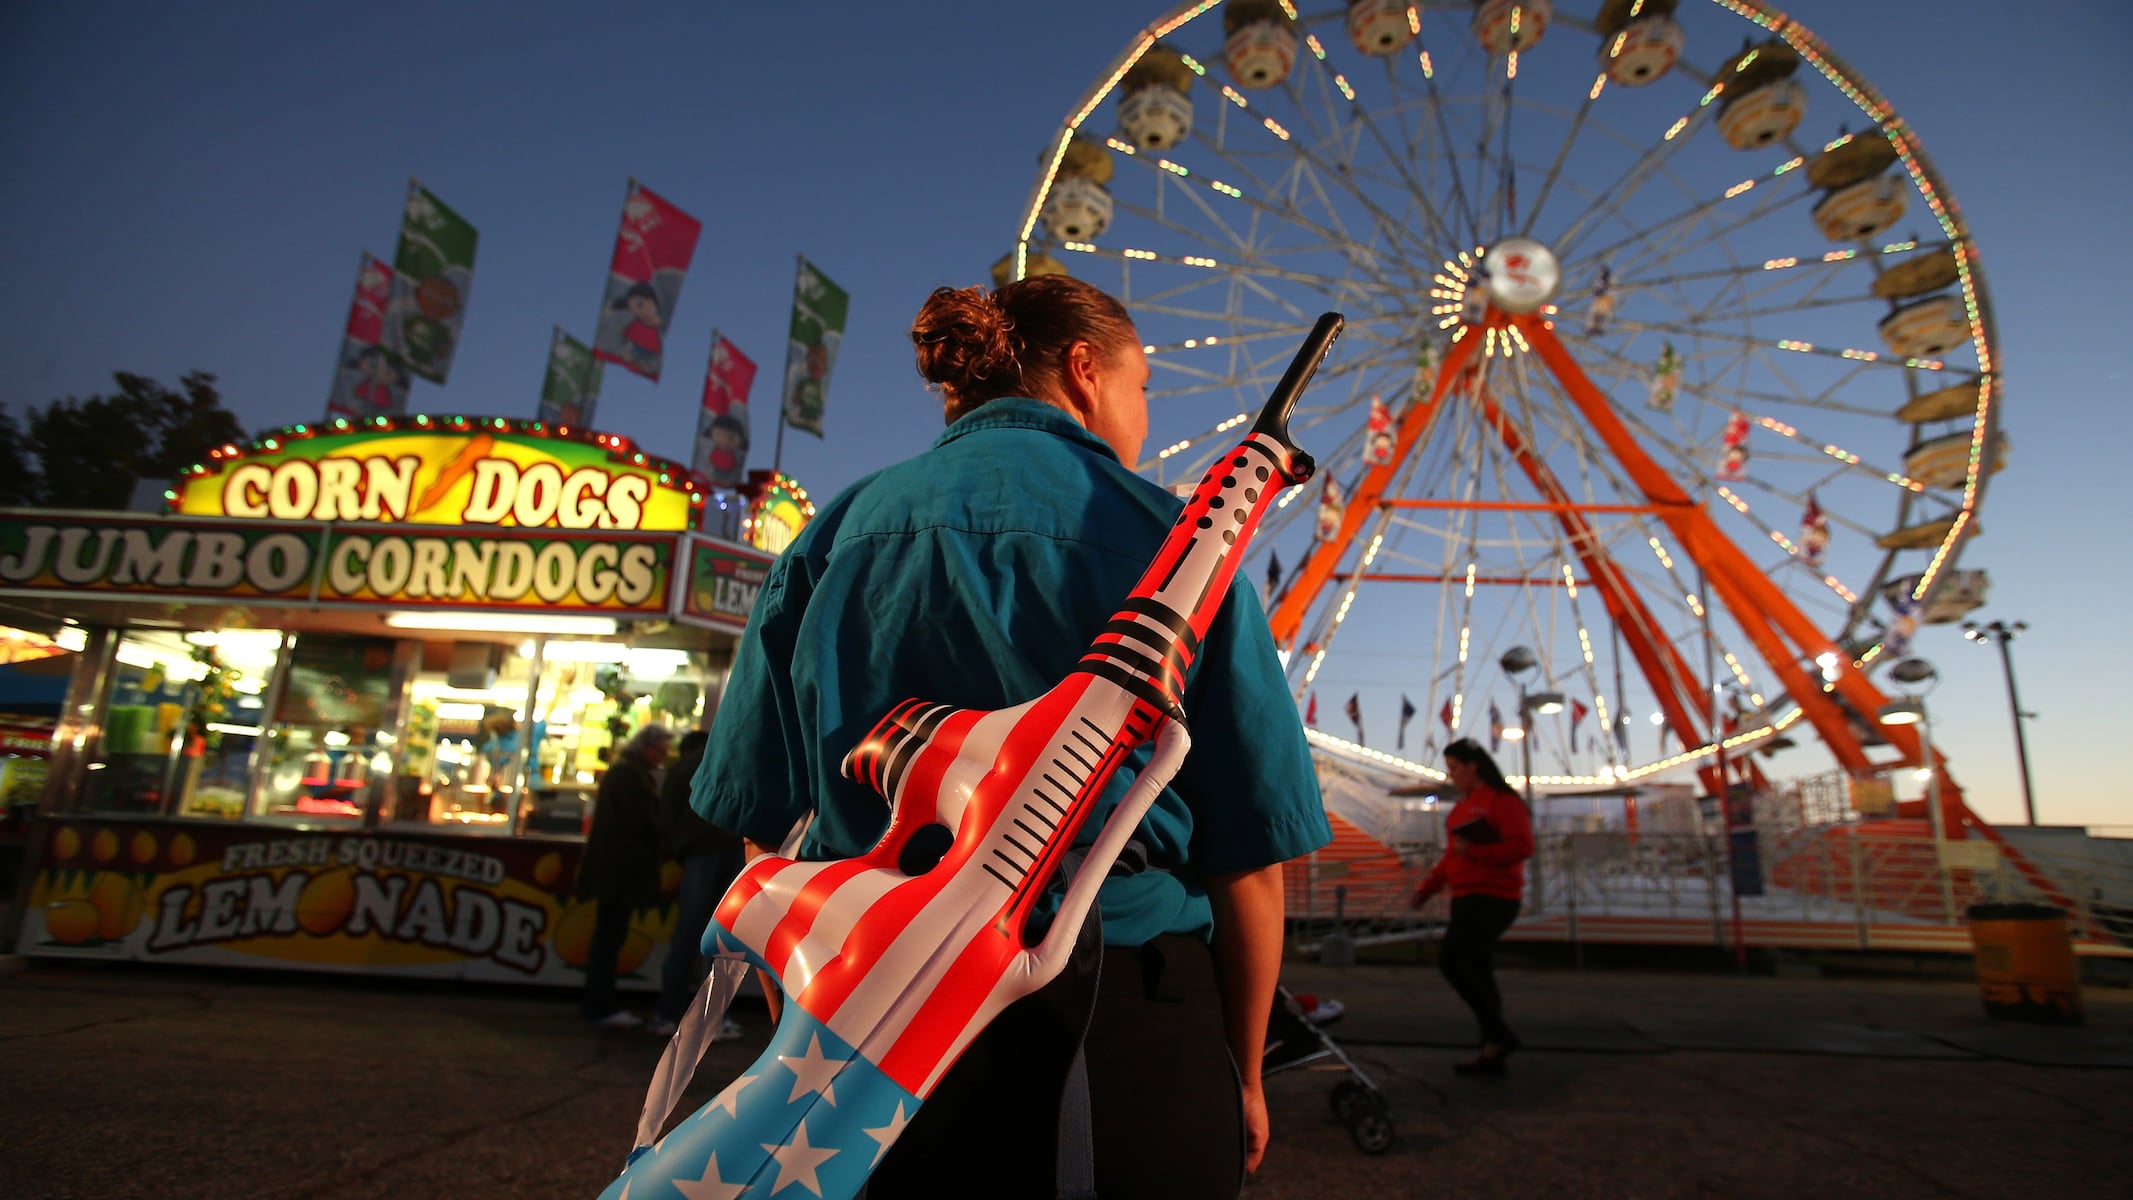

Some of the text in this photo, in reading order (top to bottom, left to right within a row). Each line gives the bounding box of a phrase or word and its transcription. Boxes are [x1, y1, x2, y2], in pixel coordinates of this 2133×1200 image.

[225, 457, 648, 529] CORN DOGS
[0, 526, 656, 603] JUMBO CORNDOGS
[223, 838, 504, 884] FRESH SQUEEZED
